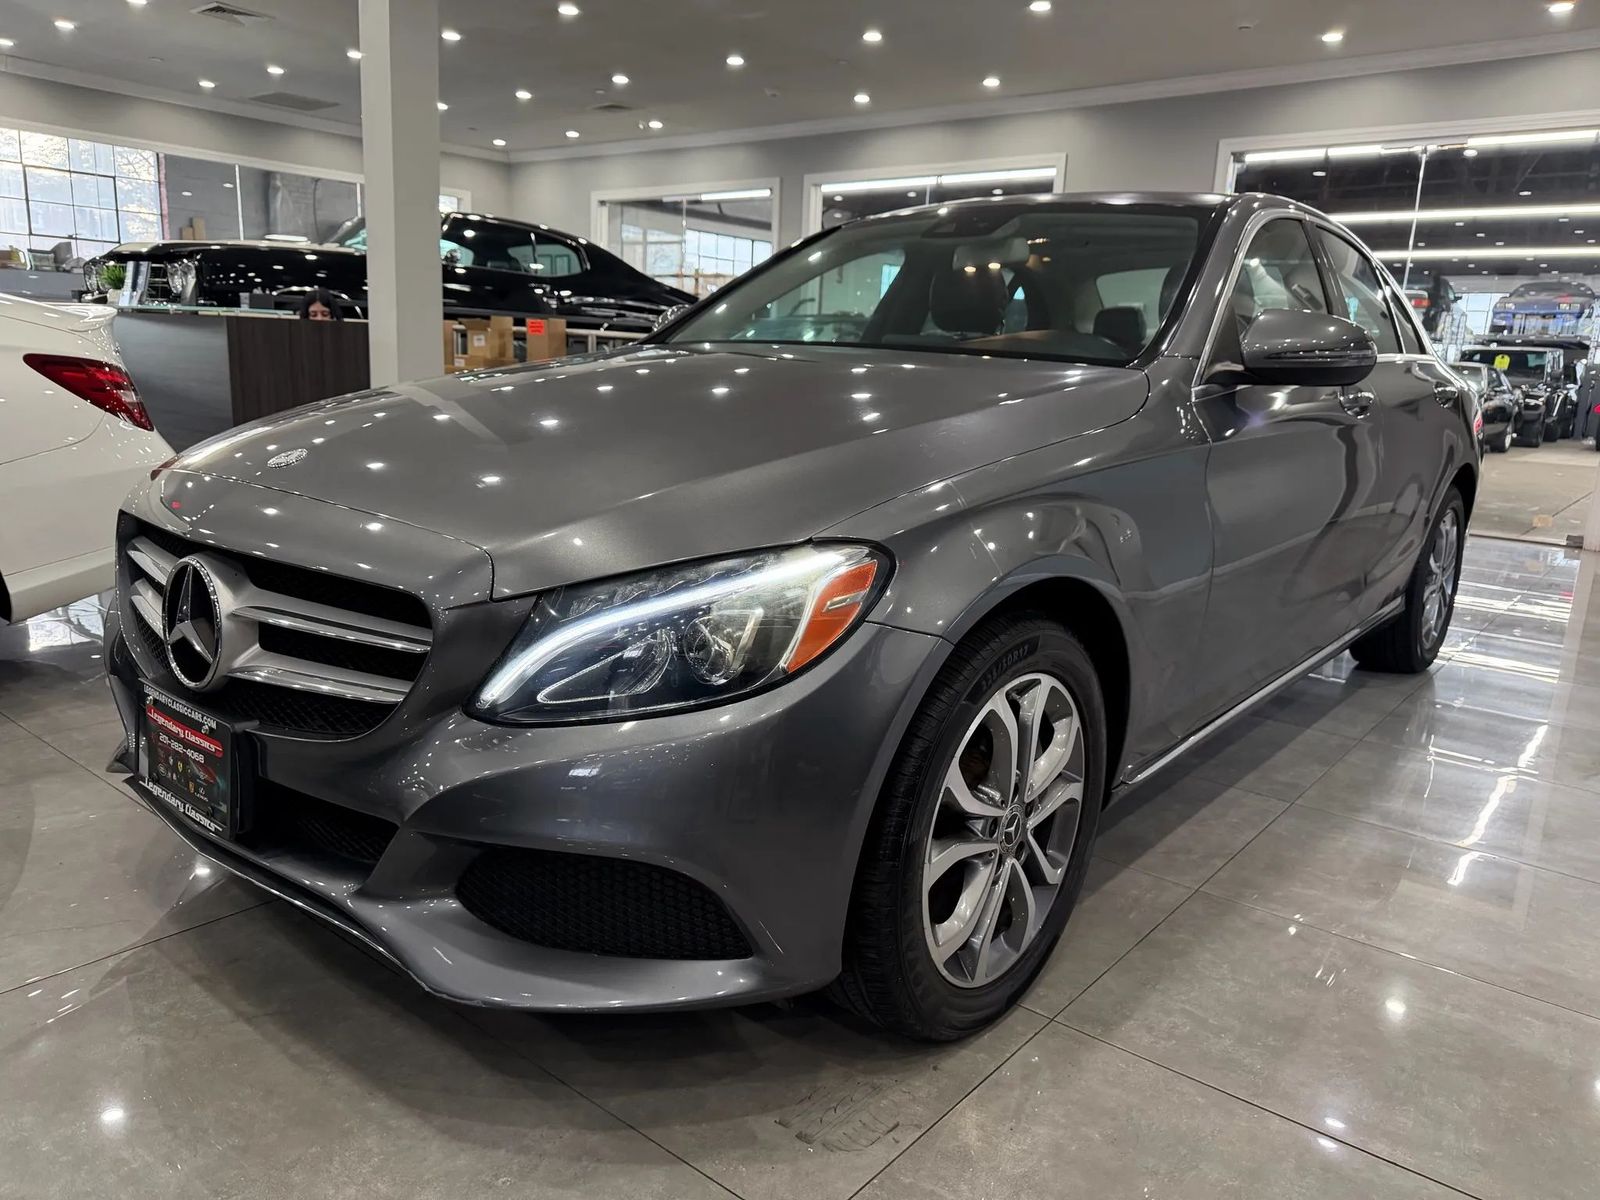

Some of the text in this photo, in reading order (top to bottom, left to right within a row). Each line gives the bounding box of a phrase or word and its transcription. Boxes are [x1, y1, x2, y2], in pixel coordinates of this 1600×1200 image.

[144, 684, 217, 729] LEGENDARYCLASSICCARS.COM
[147, 709, 223, 753] Legendary Classics
[159, 733, 205, 763] 201-282-4068
[139, 776, 223, 832] Legendary Classics
